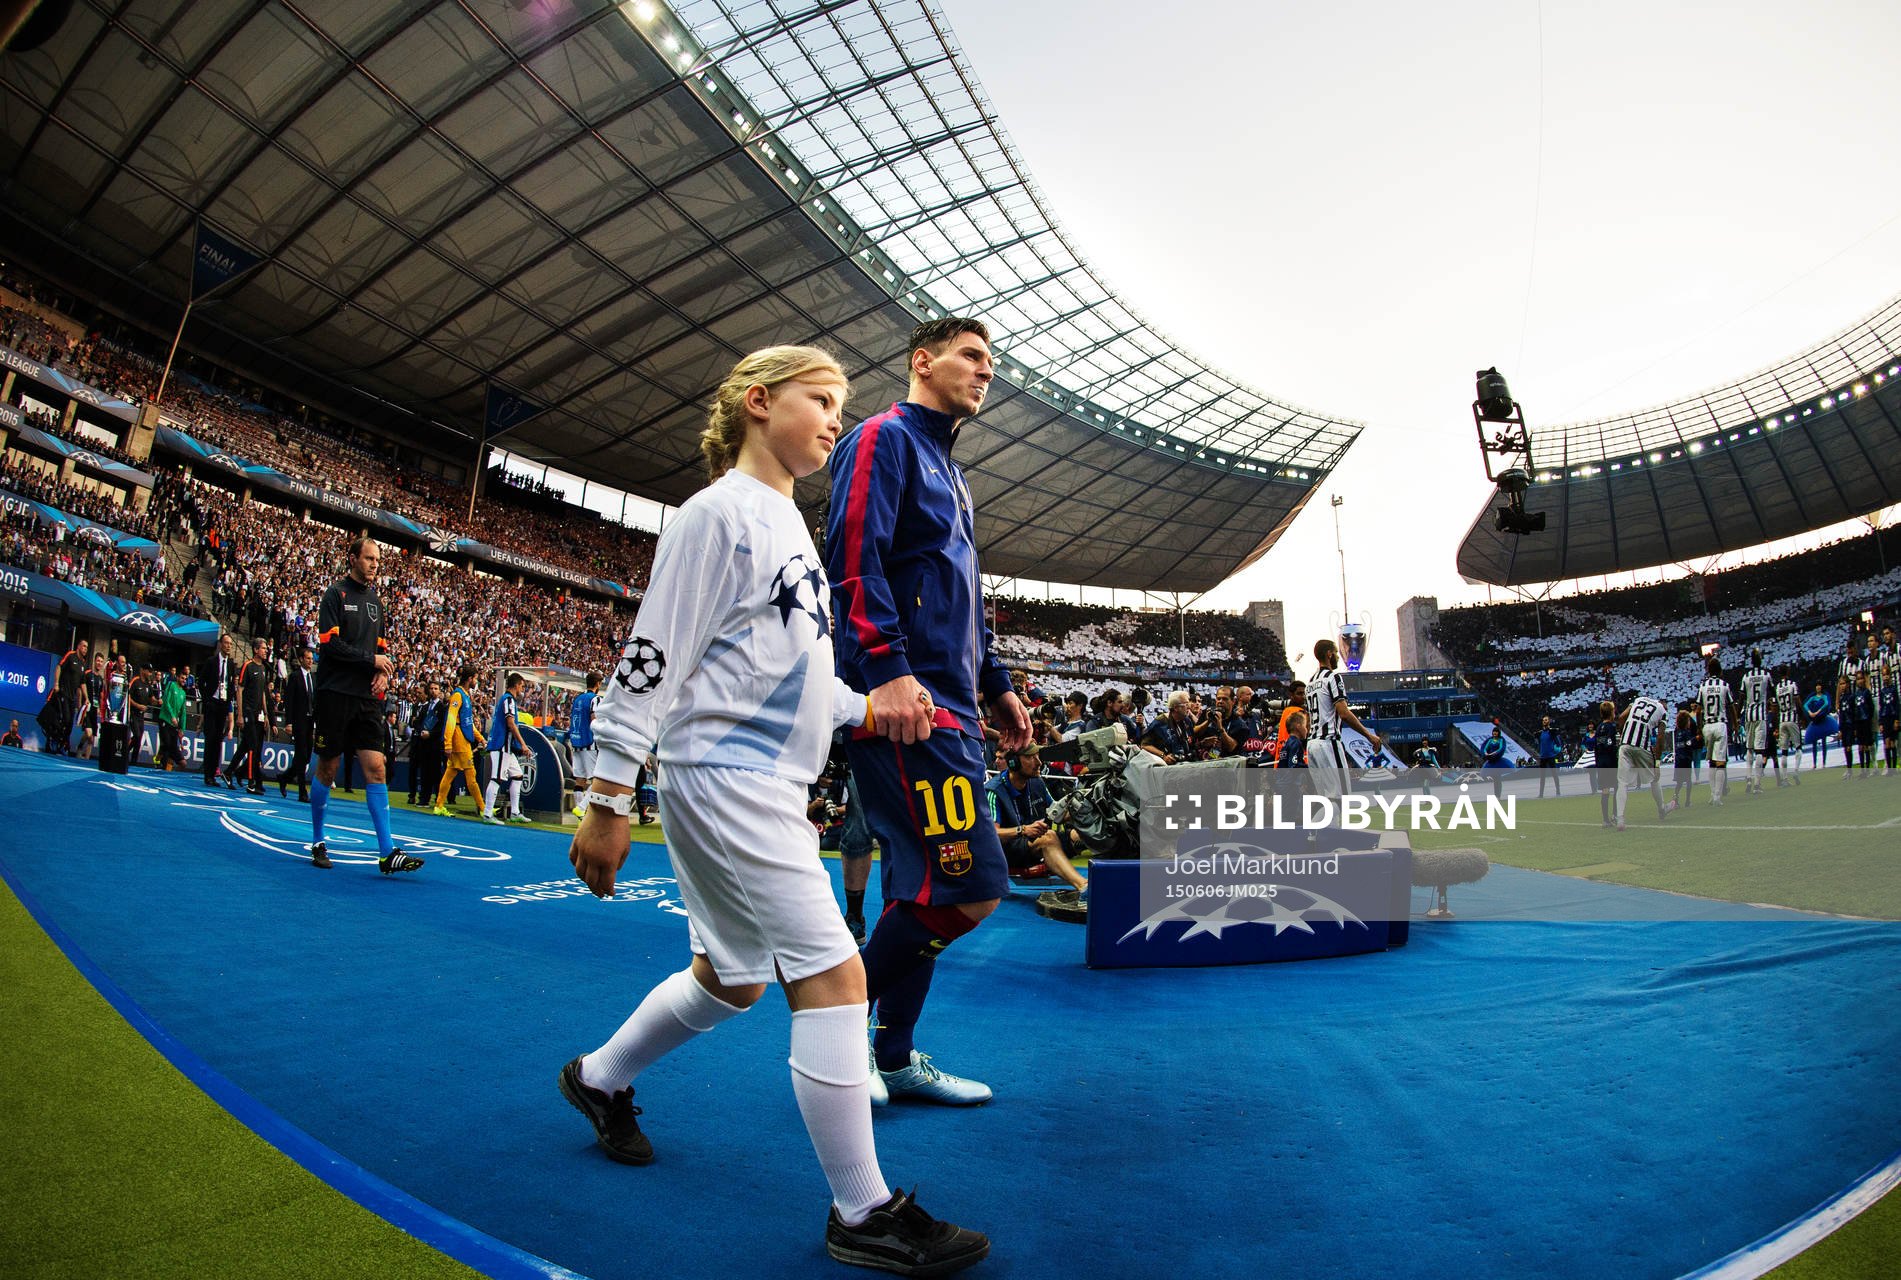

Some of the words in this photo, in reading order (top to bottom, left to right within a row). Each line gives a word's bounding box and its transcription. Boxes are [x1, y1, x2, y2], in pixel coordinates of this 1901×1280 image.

[199, 243, 237, 271] FINAL
[7, 354, 40, 377] LEAGUE
[289, 480, 320, 499] FINAL
[322, 493, 354, 512] BERLIN
[357, 505, 378, 520] 2015
[490, 549, 512, 564] UEFA
[513, 556, 559, 577] CHAMPIONS
[560, 571, 590, 586] LEAGUE
[7, 671, 29, 687] 2015
[1753, 683, 1760, 702] 6
[1778, 693, 1791, 712] 33
[1632, 701, 1657, 723] 23
[1707, 694, 1720, 716] 21
[915, 775, 976, 837] 10
[481, 876, 677, 905] CHAPIONS
